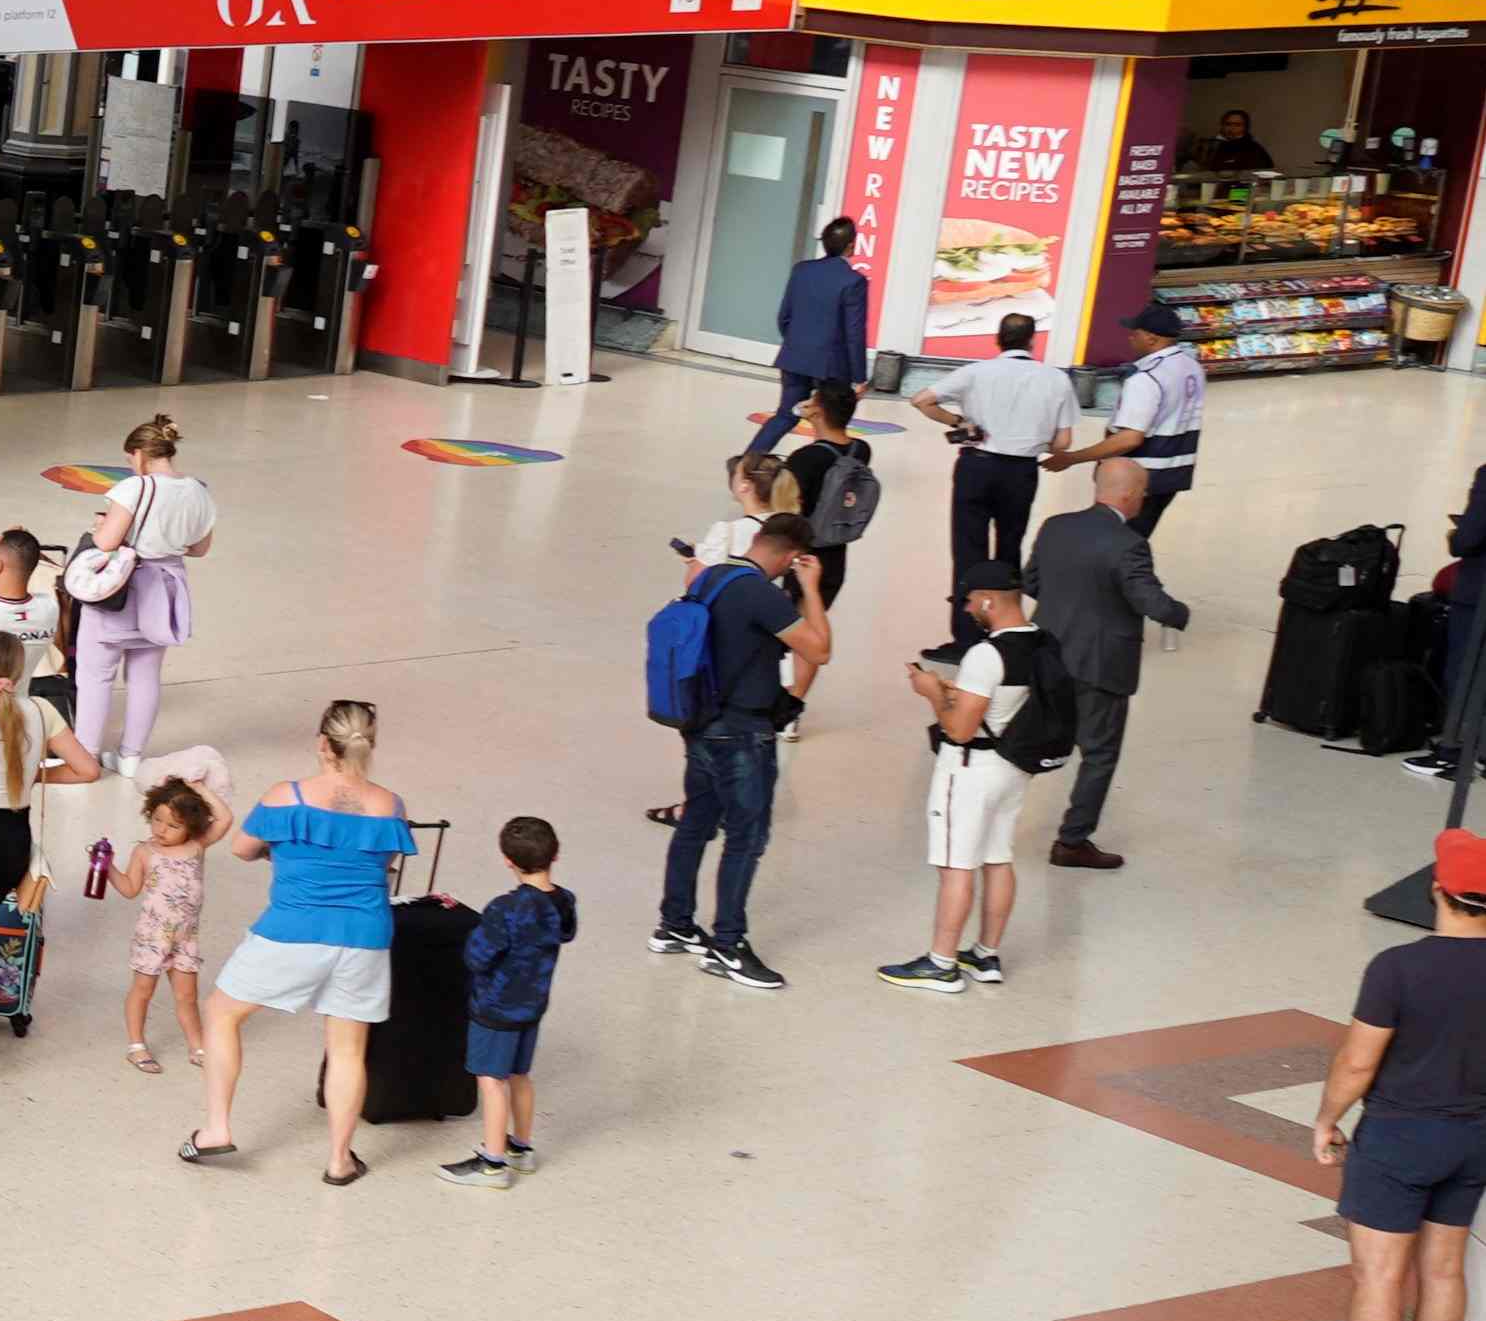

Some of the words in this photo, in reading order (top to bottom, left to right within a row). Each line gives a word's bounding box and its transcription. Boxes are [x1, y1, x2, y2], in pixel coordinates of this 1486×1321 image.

[1337, 27, 1386, 44] famously
[1386, 26, 1415, 41] fresh
[1415, 25, 1470, 43] baguettes
[868, 76, 900, 160] NEW
[971, 124, 1069, 150] TASTY
[965, 149, 1064, 181] NEW
[961, 179, 1059, 203] RECIPES
